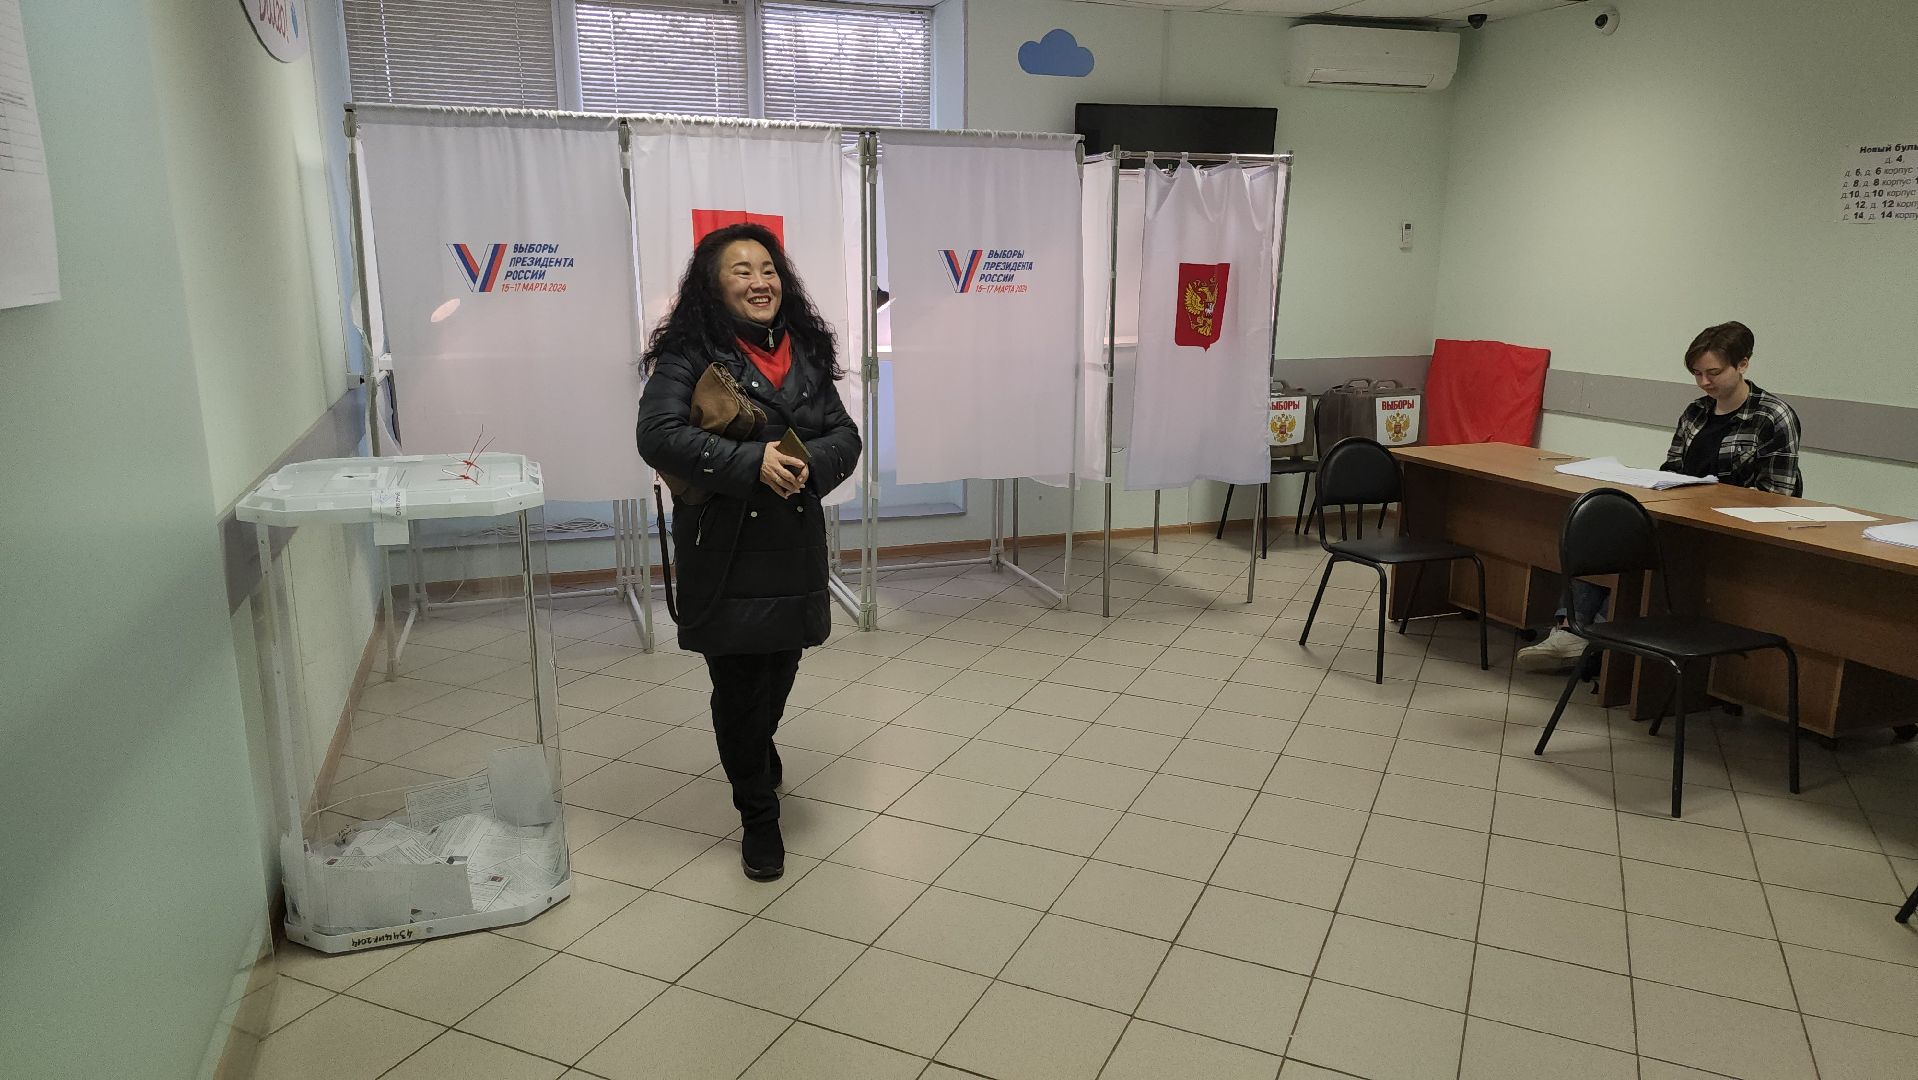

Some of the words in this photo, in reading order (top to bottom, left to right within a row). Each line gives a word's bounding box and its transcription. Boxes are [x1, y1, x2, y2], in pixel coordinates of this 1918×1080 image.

[1859, 144, 1892, 154] Новый
[1875, 167, 1882, 175] 6
[1884, 167, 1913, 177] корпус
[1873, 178, 1880, 187] 8
[1882, 178, 1911, 187] корпус
[1872, 189, 1884, 198] 10
[1886, 189, 1916, 198] корпус
[1882, 199, 1895, 208] 12
[1880, 211, 1893, 219] 14
[513, 243, 559, 254] ВЫБОРЫ
[987, 249, 1025, 259] ВЫБОРЫ
[509, 256, 574, 268] ПРЕЗИДЕНТА
[982, 261, 1034, 272] ПРЕЗИДЕНТА
[504, 269, 547, 281] РОССИИ
[978, 273, 1015, 283] РОССИИ
[522, 283, 548, 292] МАРТА
[548, 283, 567, 293] 2024
[994, 284, 1015, 293] МАРТА
[1015, 284, 1028, 293] 2024
[1269, 400, 1300, 411] ЫБОРЫ
[1381, 399, 1415, 411] ВЫБОРЫ
